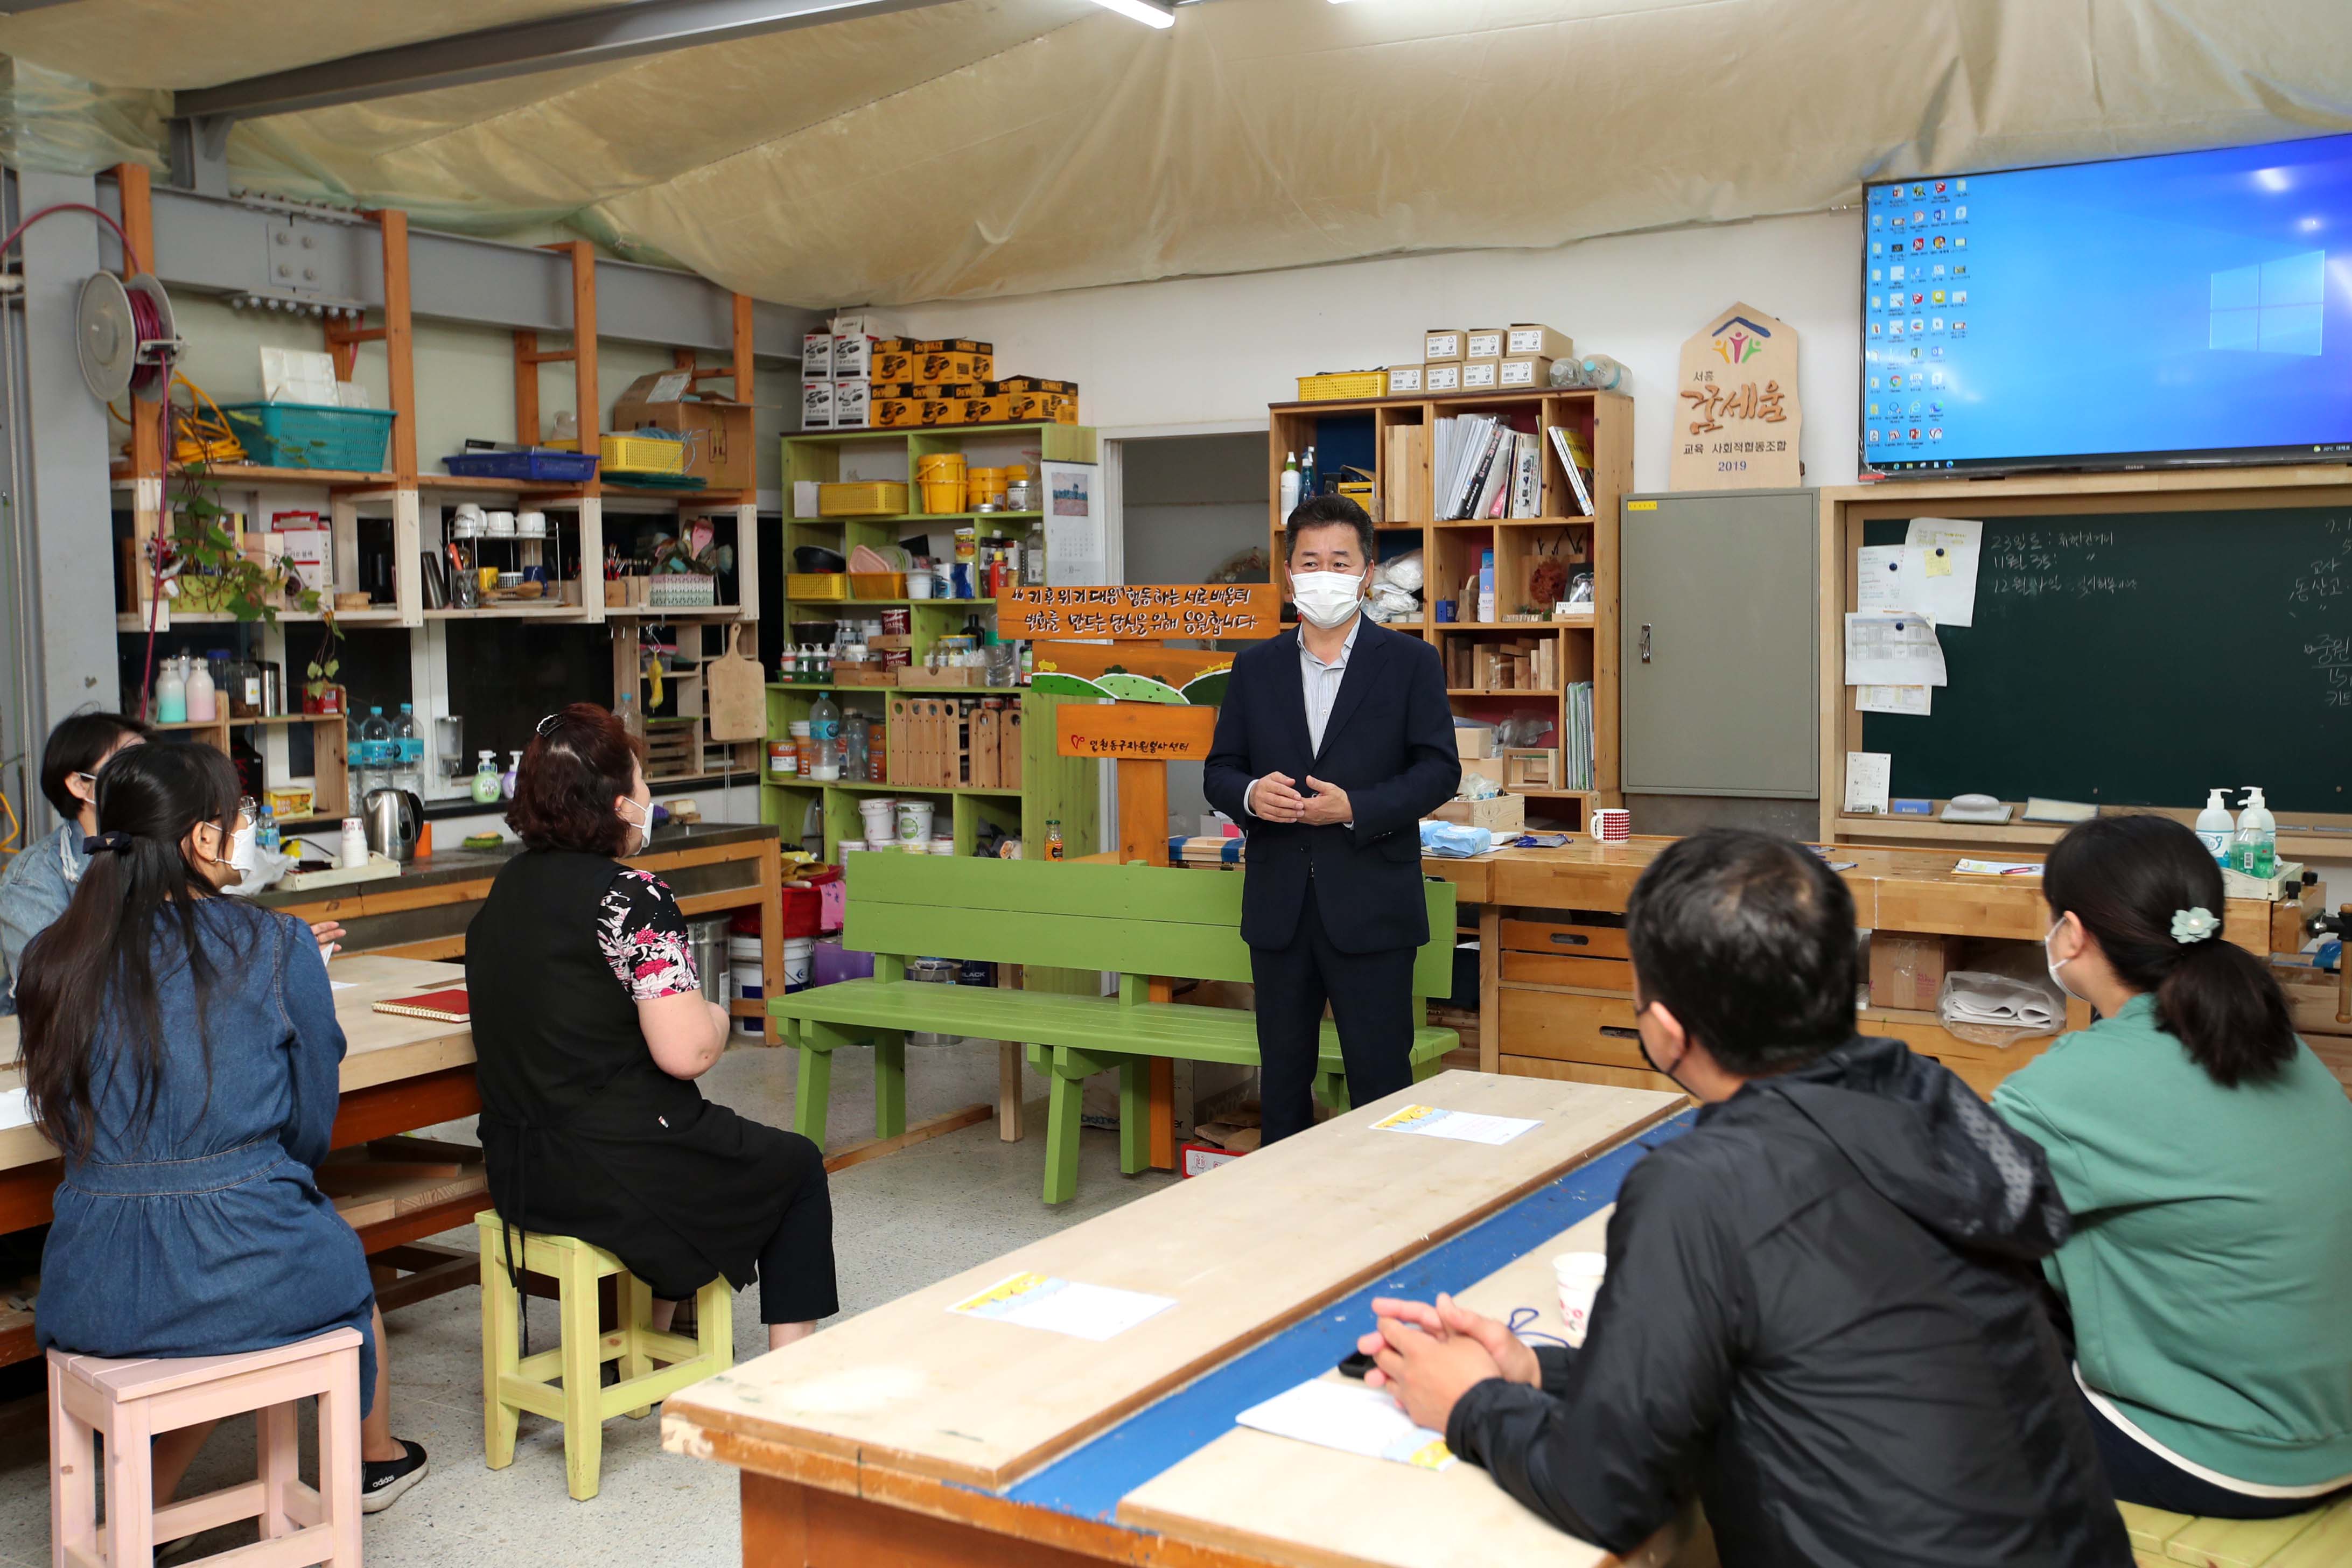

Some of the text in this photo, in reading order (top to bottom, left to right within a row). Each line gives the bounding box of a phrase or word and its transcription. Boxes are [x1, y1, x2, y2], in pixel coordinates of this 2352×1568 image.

[1683, 444, 1704, 455] 교육
[1718, 460, 1747, 472] 2019
[1025, 609, 1258, 637] 변화를 만드는 당신을 위해 응원합니다
